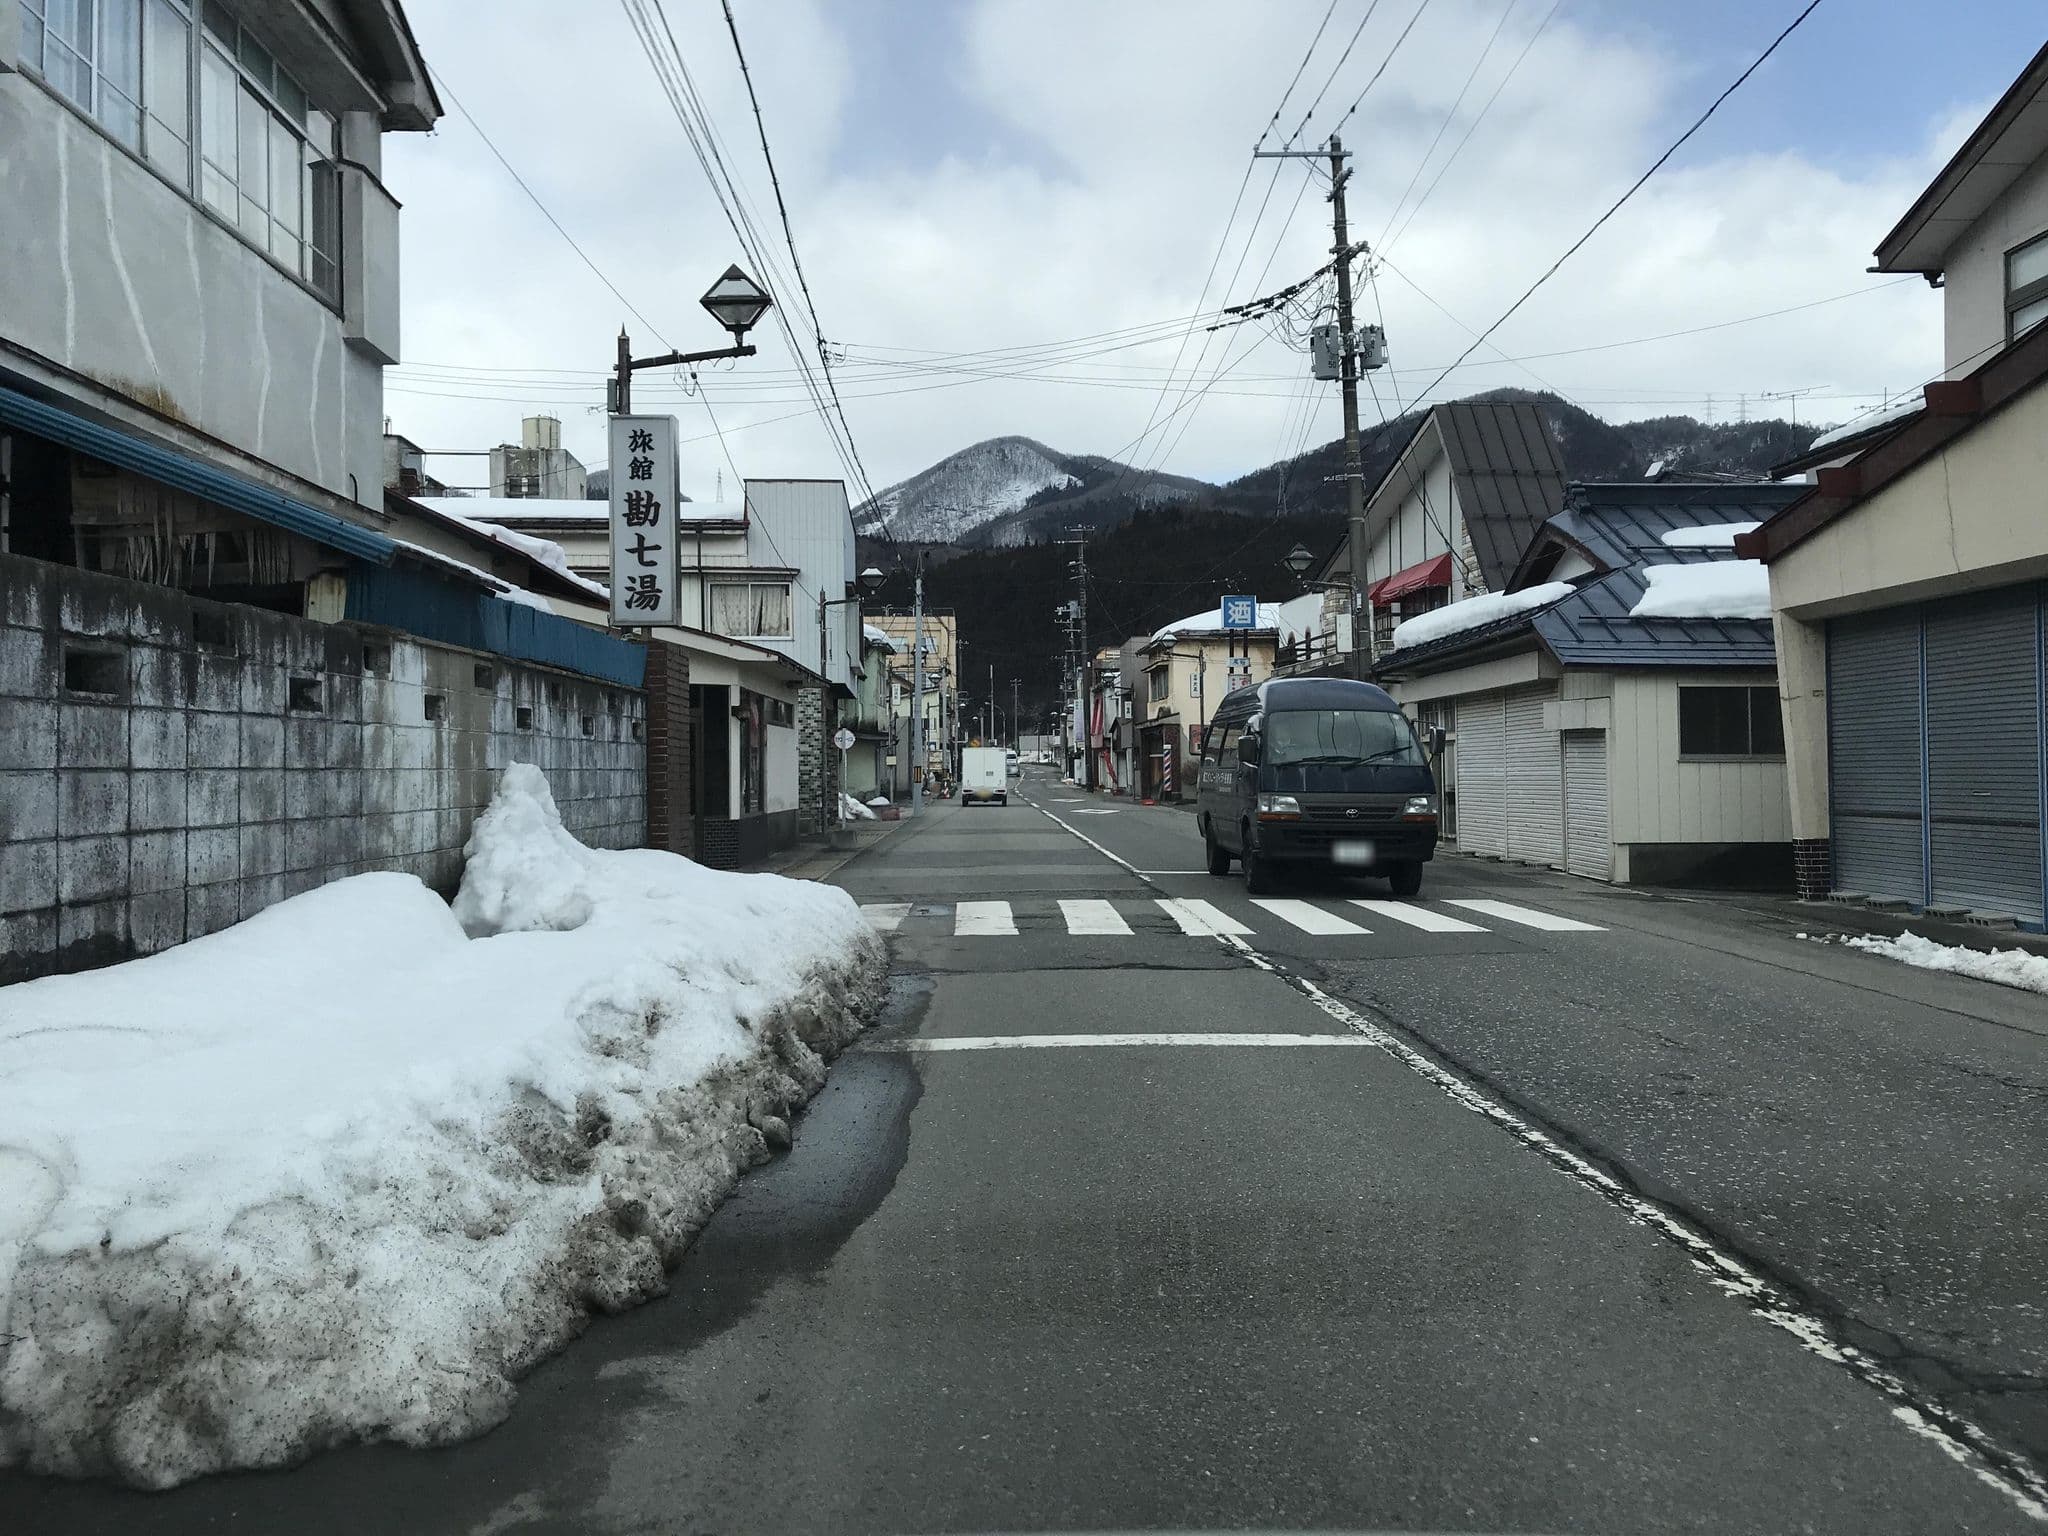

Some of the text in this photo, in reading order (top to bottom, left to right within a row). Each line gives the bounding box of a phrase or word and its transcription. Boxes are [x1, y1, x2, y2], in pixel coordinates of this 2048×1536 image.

[1328, 360, 1337, 368] 50
[622, 429, 662, 611] 旅館勘七湯
[1228, 600, 1251, 624] 酒
